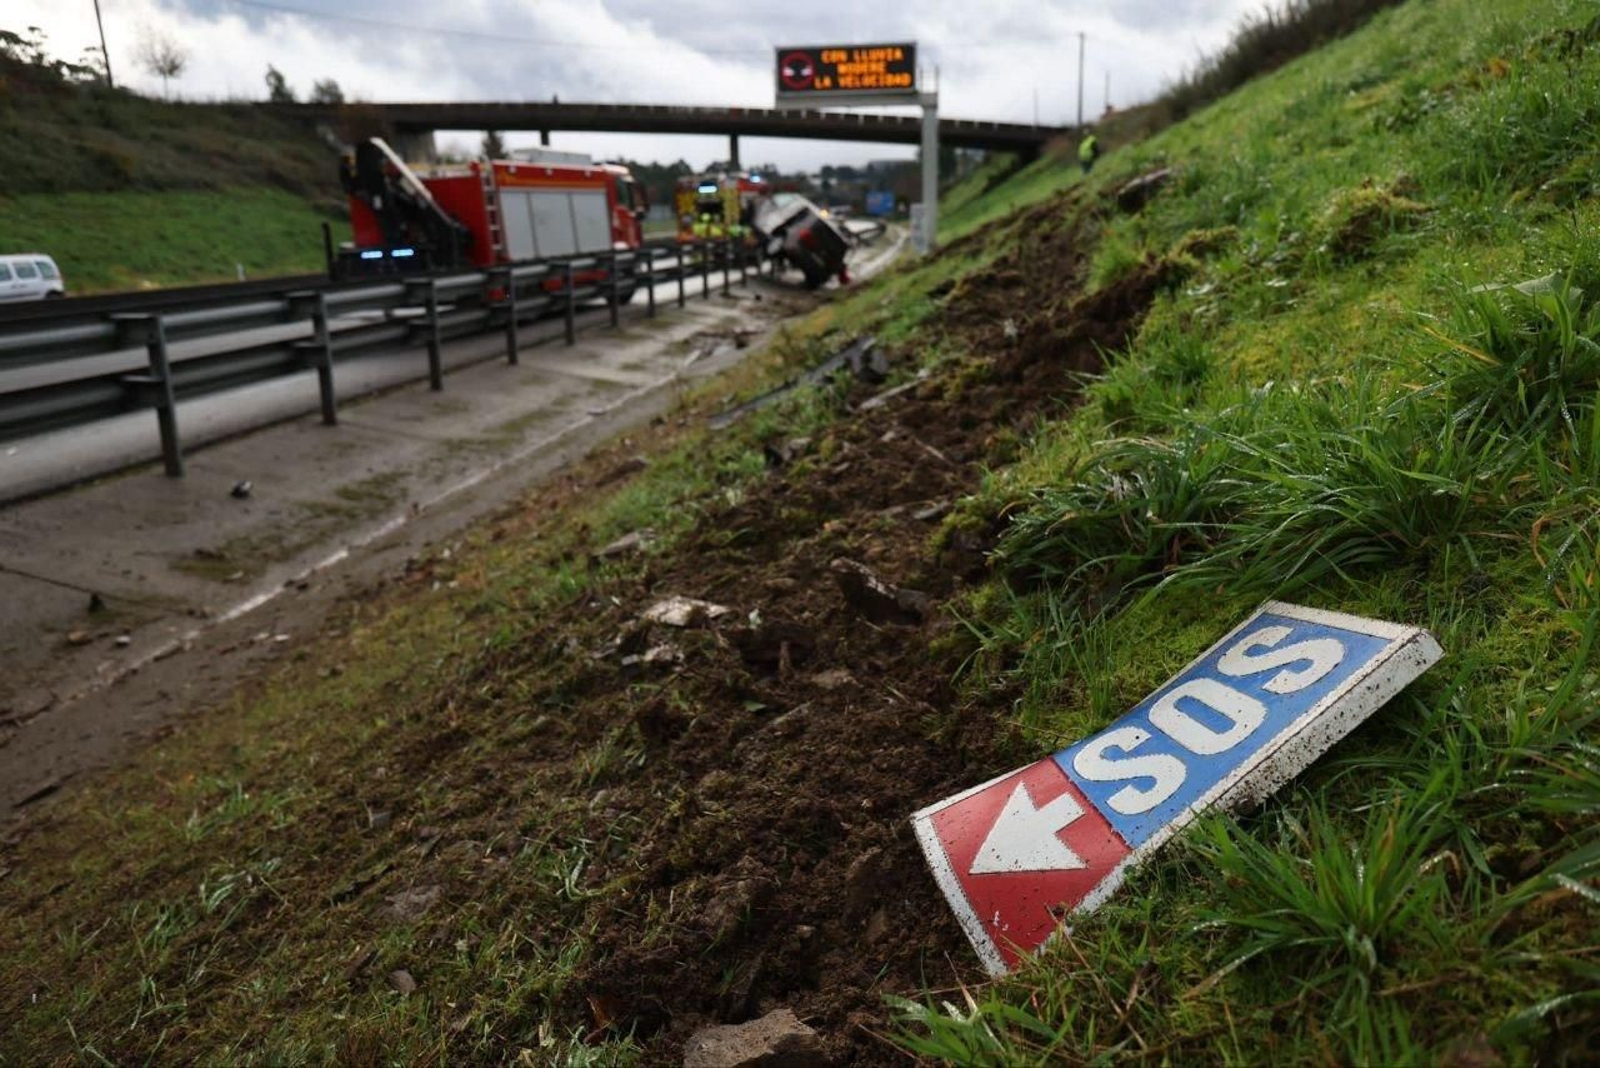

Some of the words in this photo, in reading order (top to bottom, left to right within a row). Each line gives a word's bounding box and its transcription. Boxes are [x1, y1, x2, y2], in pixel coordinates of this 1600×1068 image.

[821, 50, 848, 63] CON
[853, 47, 904, 62] LLUVIA
[814, 75, 832, 89] LA
[838, 73, 911, 88] VELOCIDAD
[1073, 625, 1346, 816] SOS
